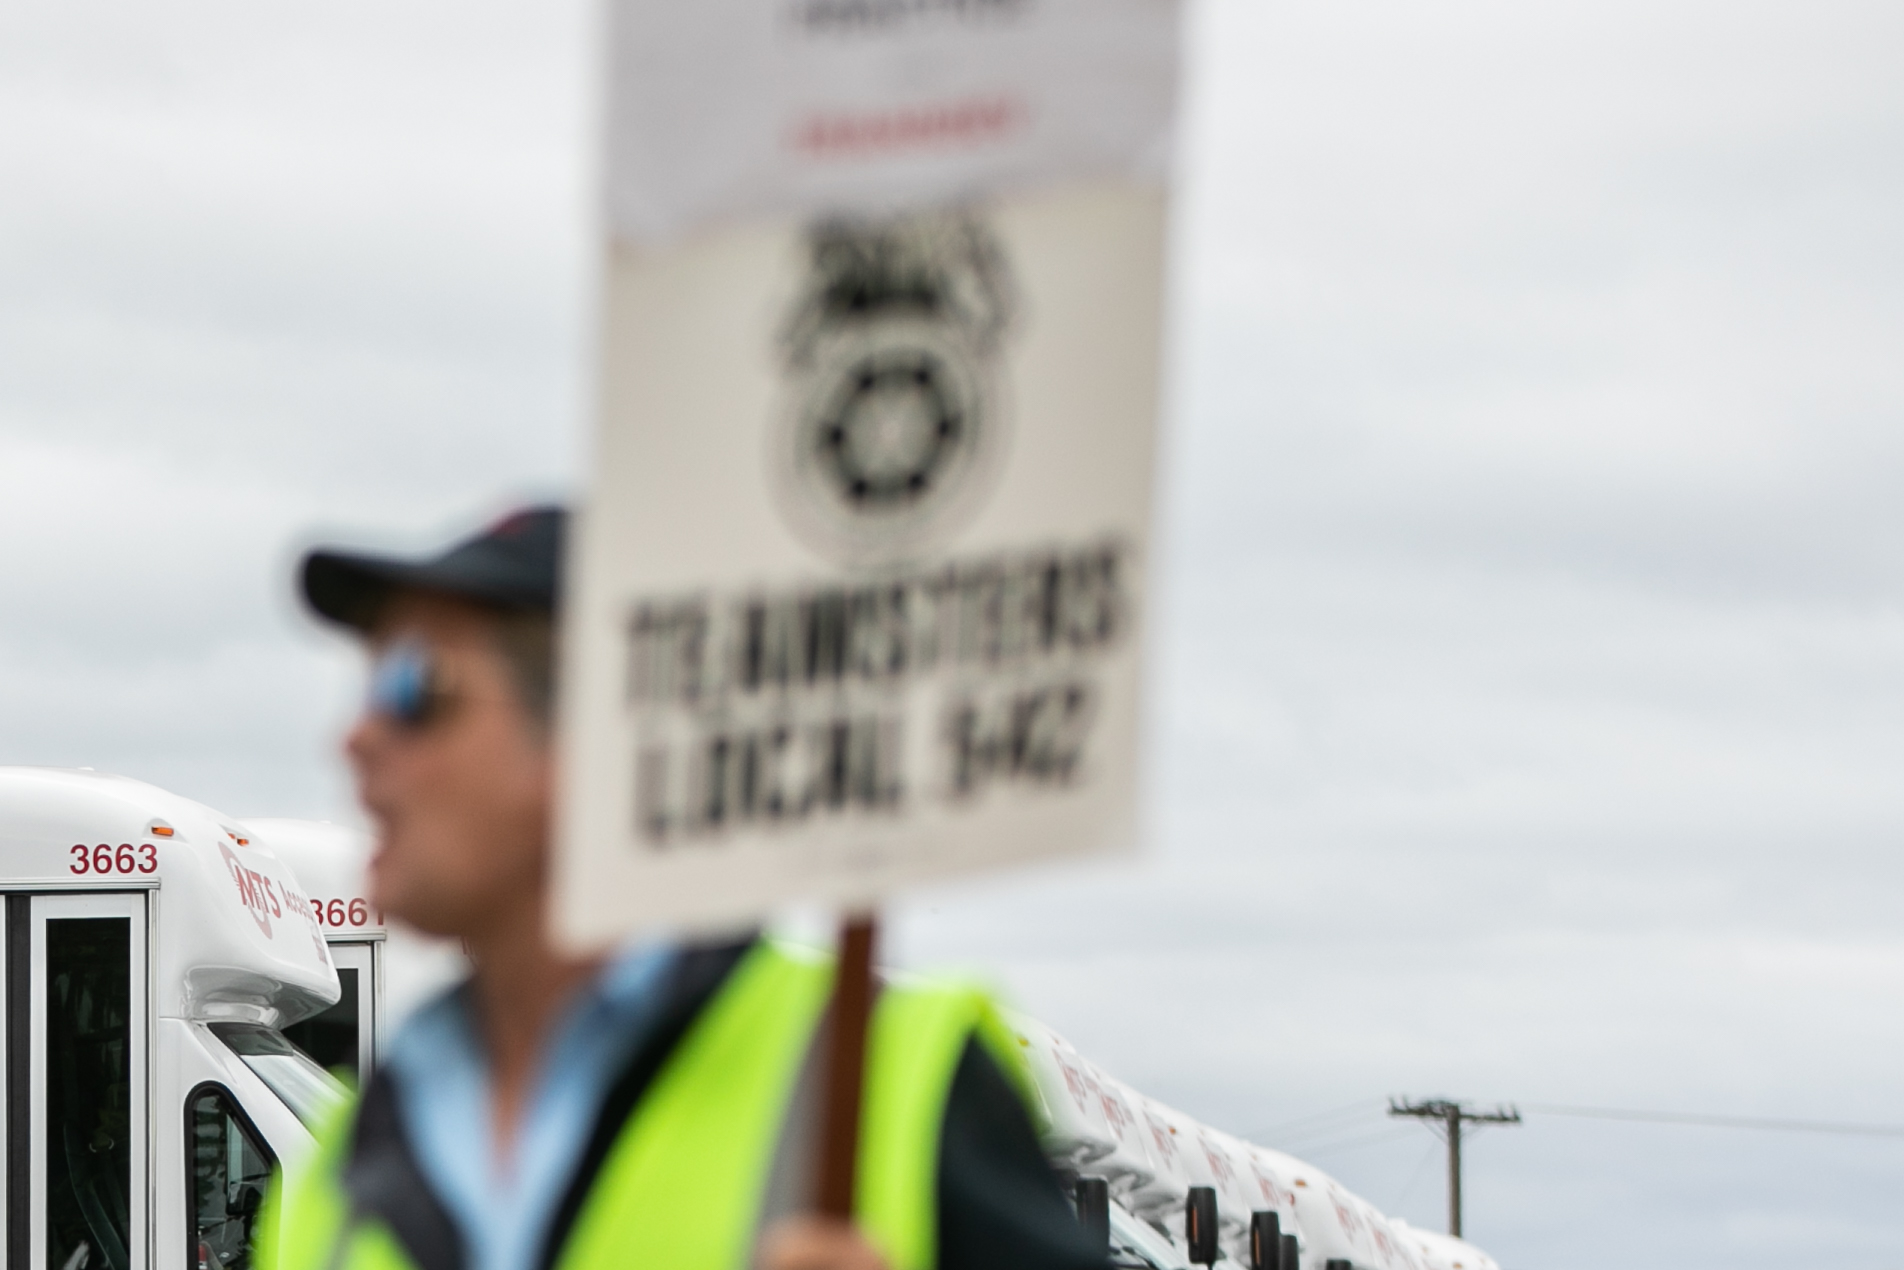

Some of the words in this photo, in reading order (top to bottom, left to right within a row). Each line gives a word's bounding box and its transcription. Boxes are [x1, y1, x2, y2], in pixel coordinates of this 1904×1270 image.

[634, 720, 901, 840] LOCAL
[69, 843, 158, 875] 3663
[234, 864, 282, 919] MTS
